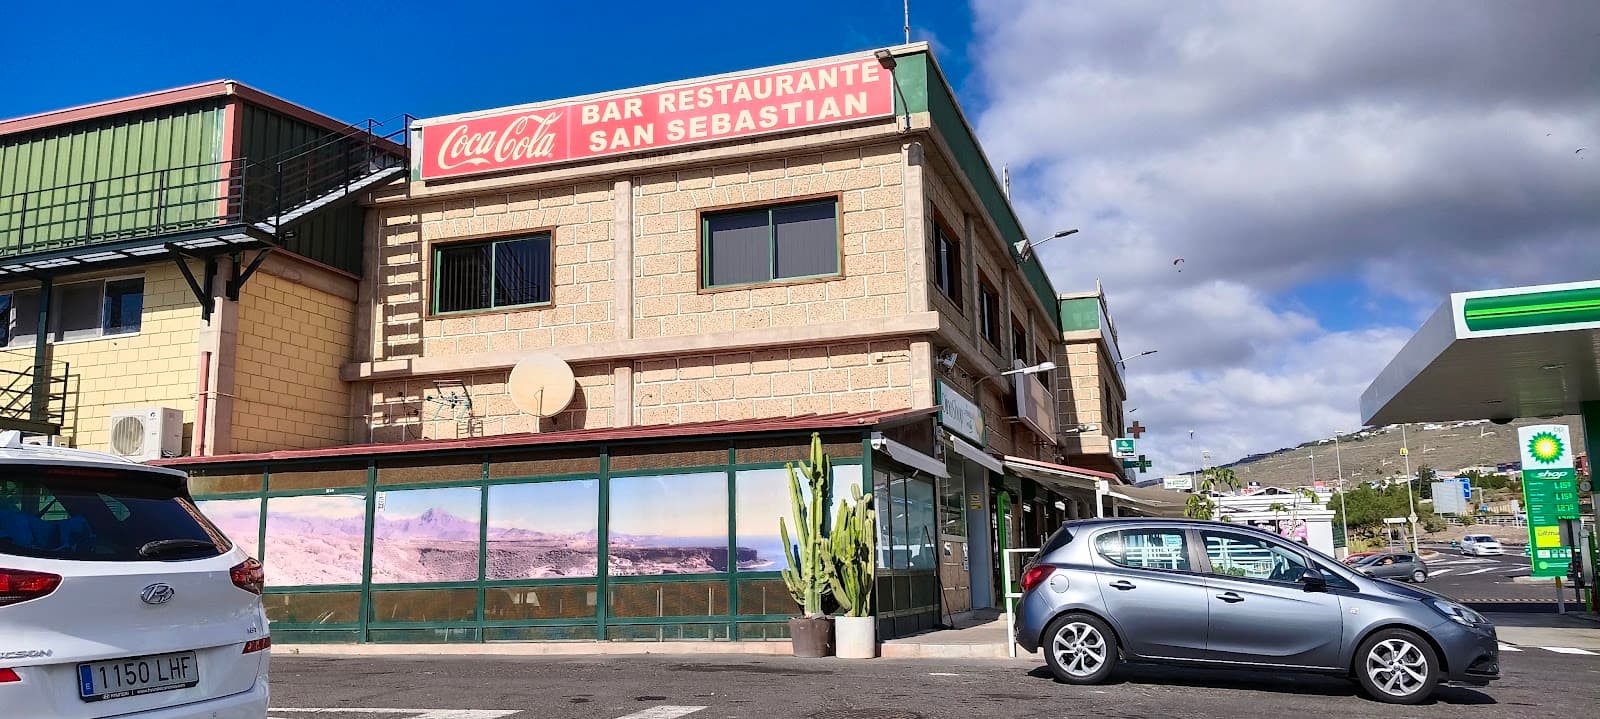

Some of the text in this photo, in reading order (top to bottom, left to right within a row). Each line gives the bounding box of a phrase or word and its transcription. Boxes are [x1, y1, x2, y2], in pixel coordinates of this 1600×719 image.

[581, 61, 880, 125] BAR RESTAURANTE
[589, 91, 868, 152] SAN SEBASTIAN
[1537, 470, 1568, 479] shop
[85, 682, 92, 690] E
[99, 661, 150, 689] 1150
[156, 656, 191, 682] LHF
